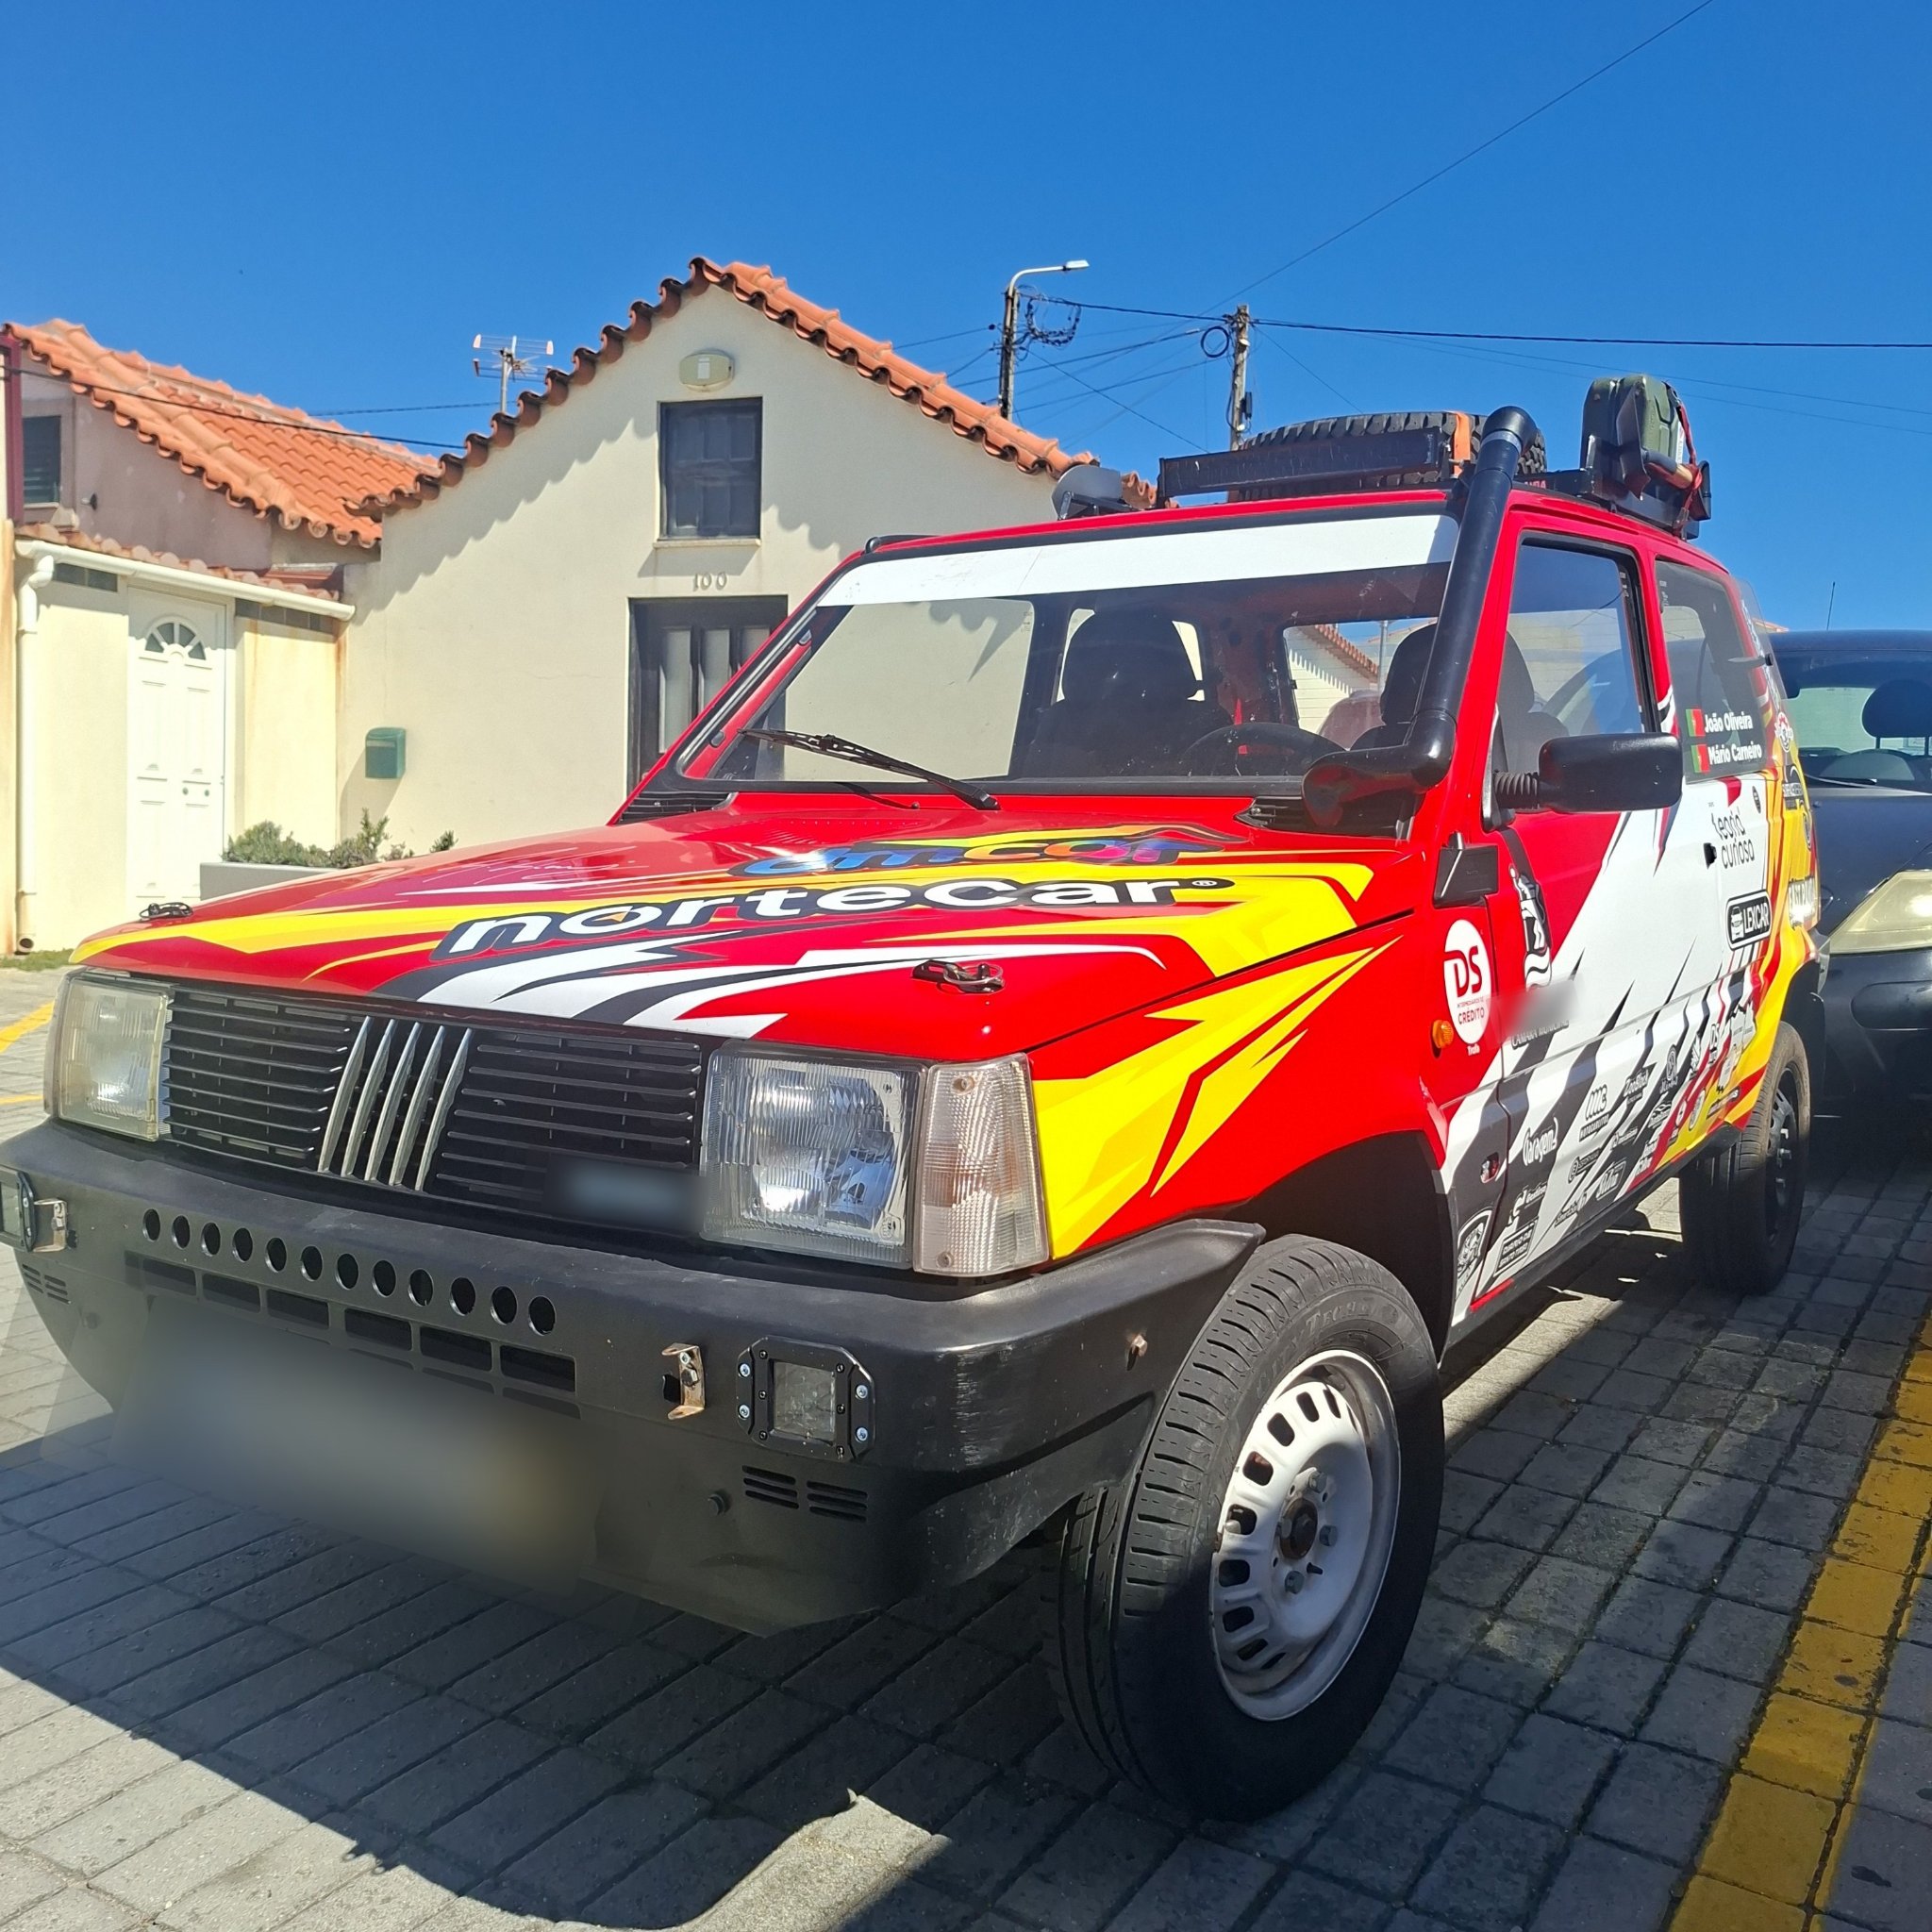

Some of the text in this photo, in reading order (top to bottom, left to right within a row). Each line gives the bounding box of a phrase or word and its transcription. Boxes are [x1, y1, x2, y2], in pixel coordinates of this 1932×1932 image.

[692, 572, 727, 591] 100
[1705, 710, 1754, 733] João Oliveira
[1707, 741, 1762, 765] Mário Carneiro
[1722, 837, 1755, 869] curiosa
[1743, 901, 1770, 933] LEXCAR
[1444, 945, 1483, 998] DS
[1458, 1007, 1485, 1025] CRÉDITO
